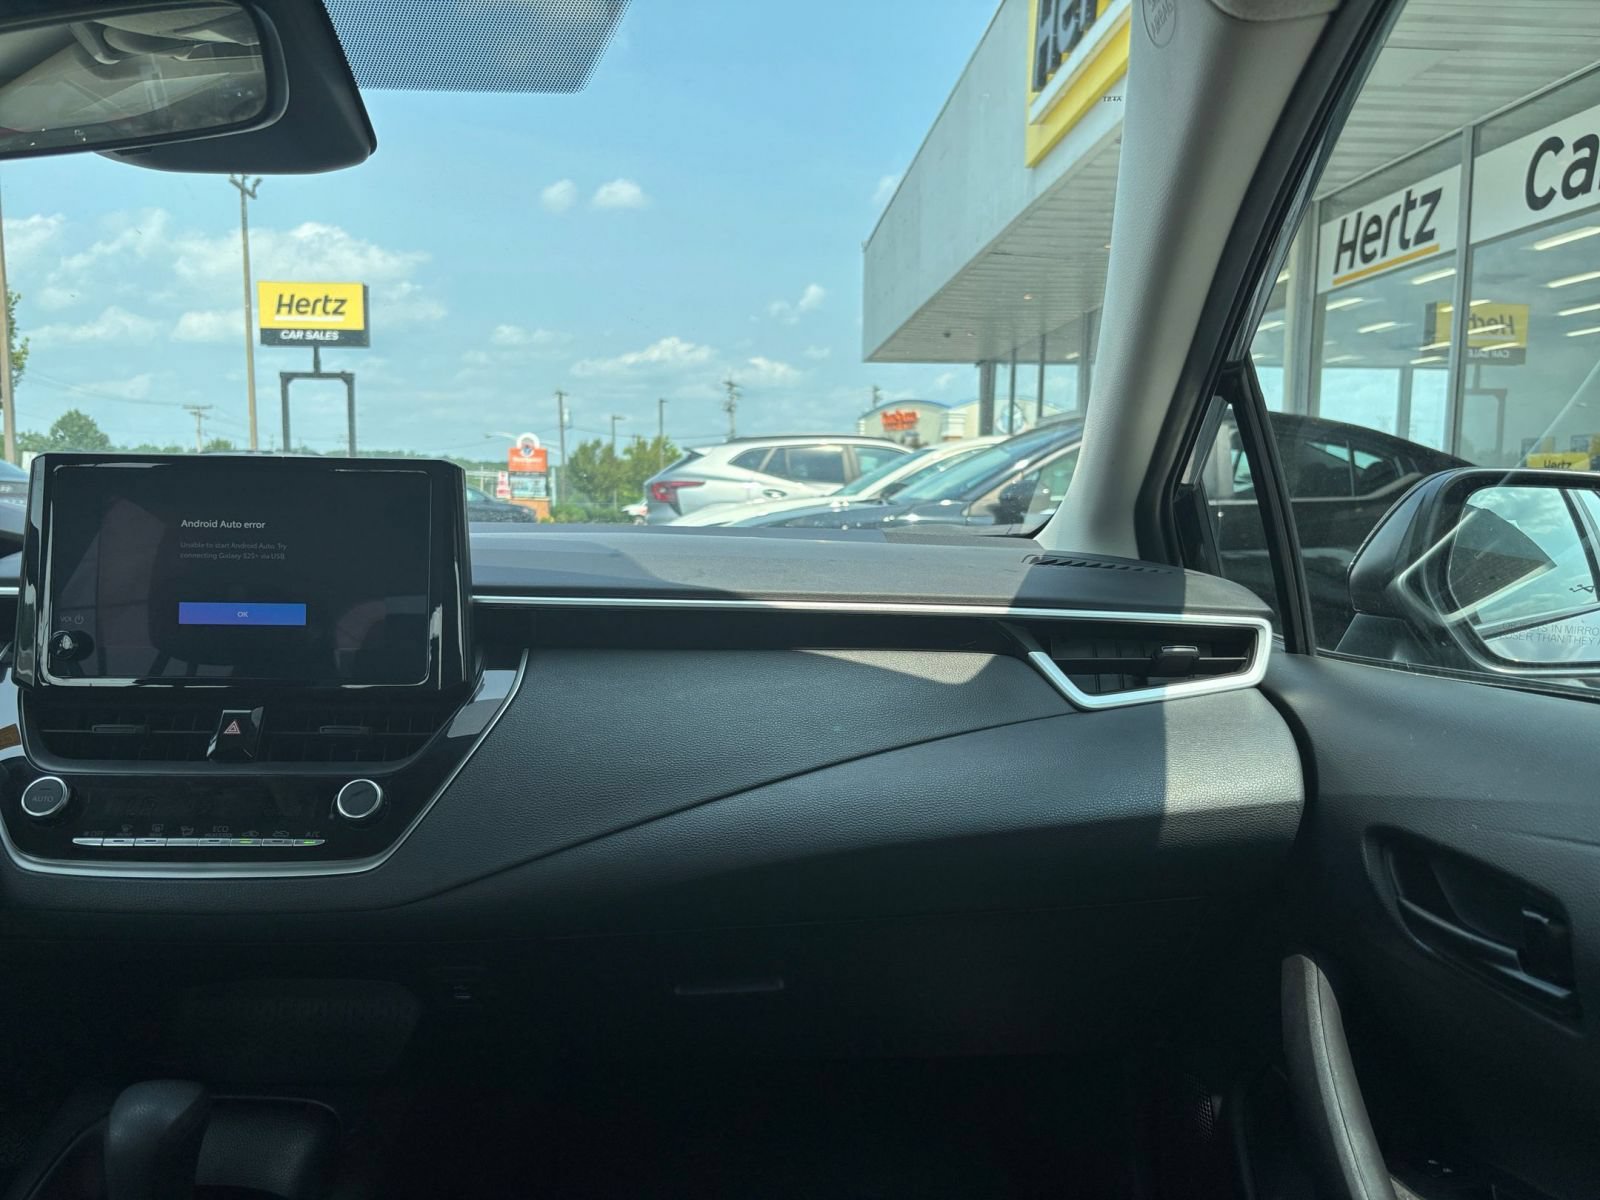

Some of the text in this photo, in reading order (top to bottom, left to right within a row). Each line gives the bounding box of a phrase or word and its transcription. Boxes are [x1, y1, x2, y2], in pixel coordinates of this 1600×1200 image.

[1333, 133, 1600, 274] Hertz Ca
[275, 294, 347, 315] Hertz
[280, 329, 339, 341] CAR SALES
[180, 519, 266, 529] Android Auto error
[180, 552, 218, 560] connecting
[218, 552, 241, 560] Galaxy
[1551, 624, 1562, 634] IN
[1536, 632, 1564, 643] THAN
[1565, 634, 1595, 646] THEY
[31, 794, 54, 803] AUTO
[212, 825, 230, 833] ECO
